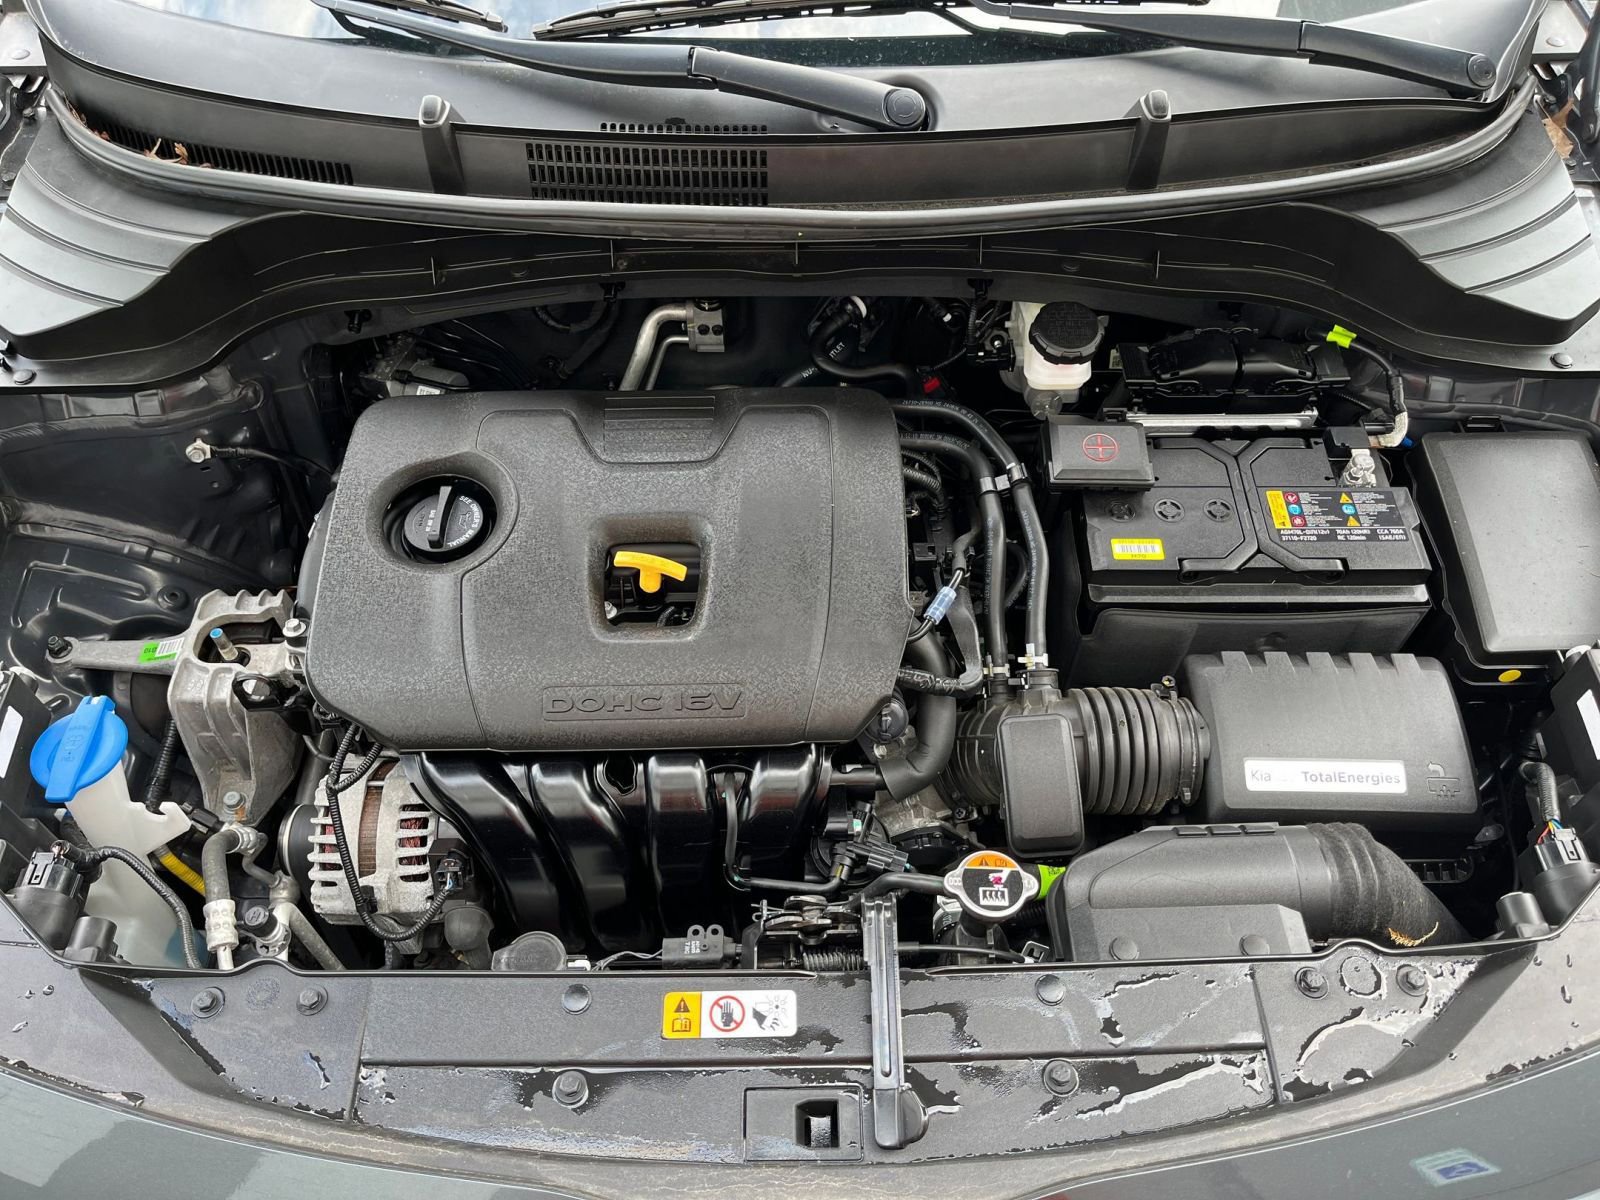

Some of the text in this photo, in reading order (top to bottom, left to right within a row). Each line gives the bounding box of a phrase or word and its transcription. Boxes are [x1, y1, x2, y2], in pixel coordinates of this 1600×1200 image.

[459, 495, 473, 505] SEE
[545, 692, 742, 713] DOHC 16V
[1250, 769, 1272, 783] Kia
[1301, 770, 1401, 786] TotalEnergies
